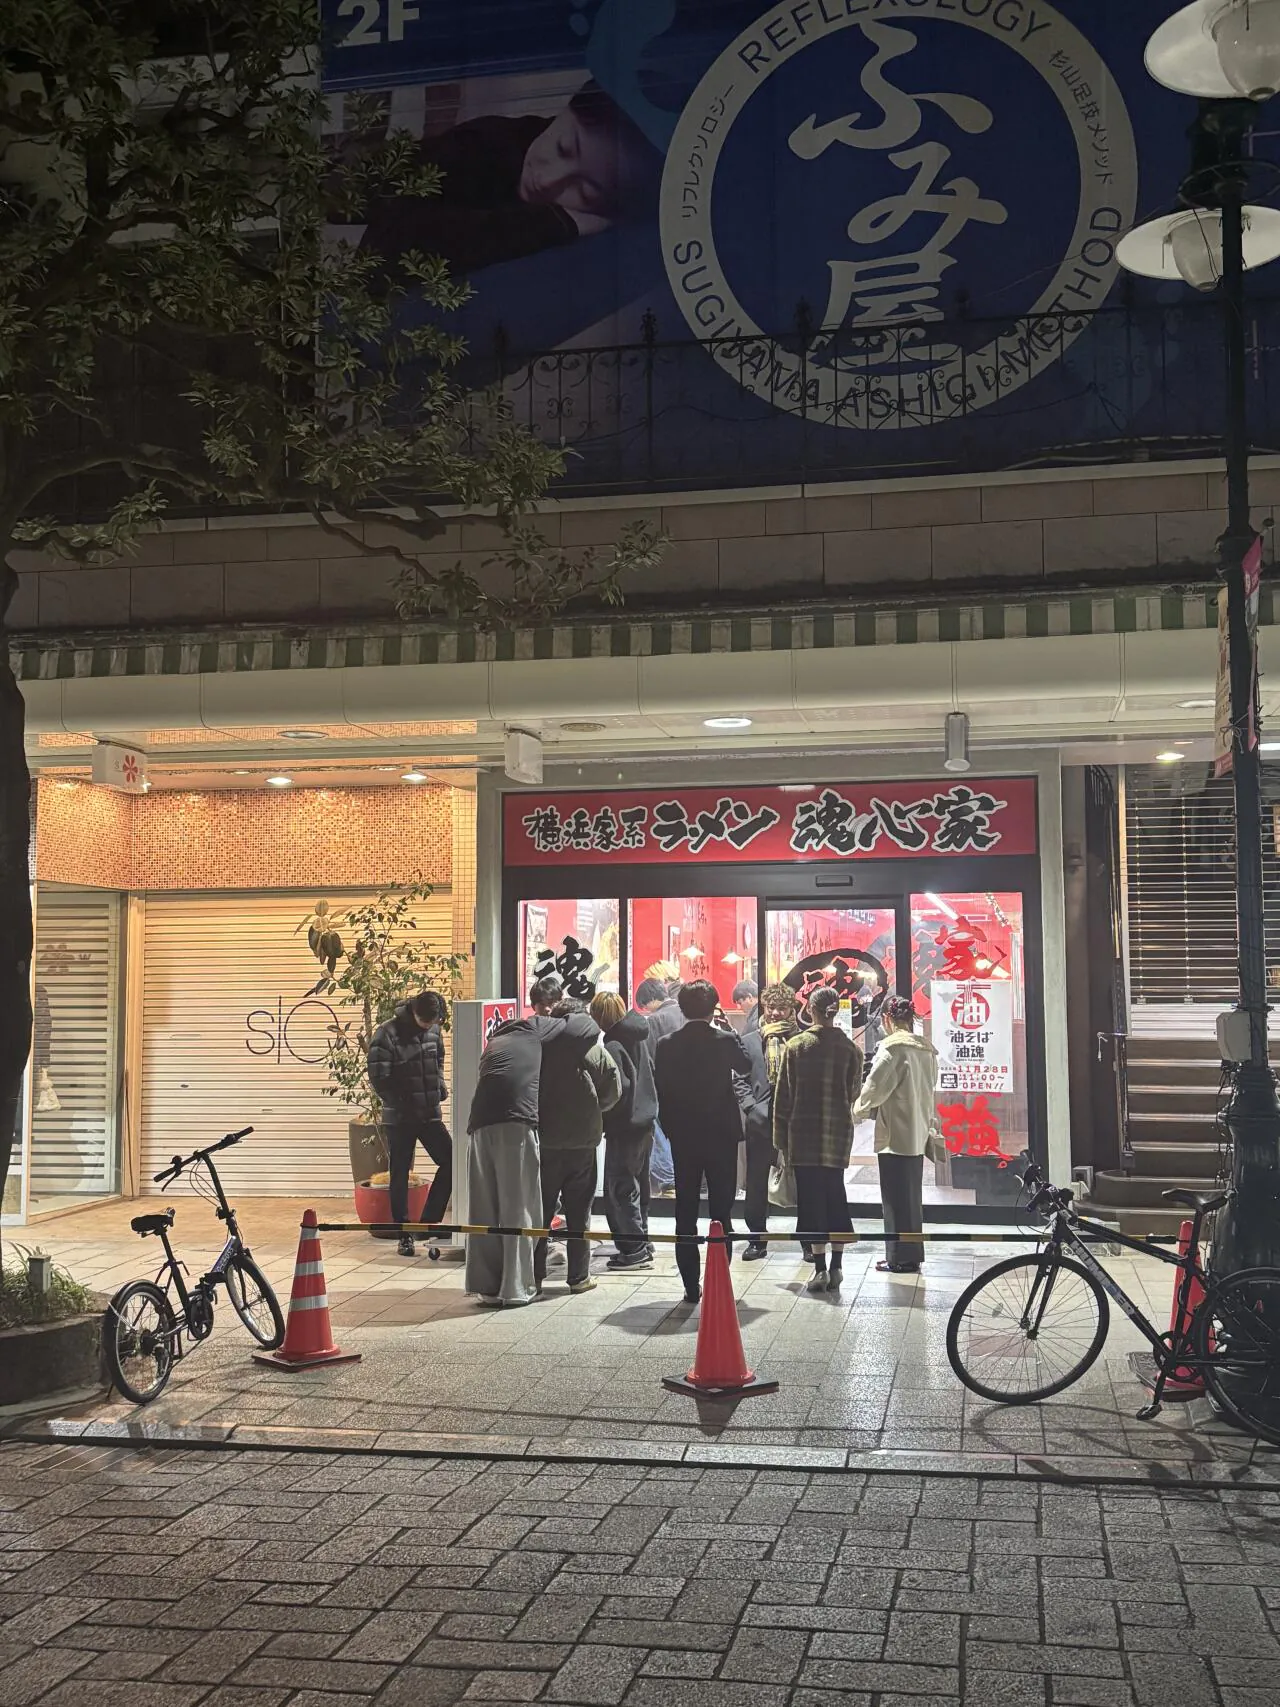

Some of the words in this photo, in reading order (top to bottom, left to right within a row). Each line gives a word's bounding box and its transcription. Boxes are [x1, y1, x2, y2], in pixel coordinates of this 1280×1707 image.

[336, 0, 421, 48] 2F
[681, 84, 735, 219] リフレクソロジー
[790, 785, 1008, 855] 魂心家
[949, 1030, 994, 1044] 油そば
[955, 1044, 985, 1058] 油魂
